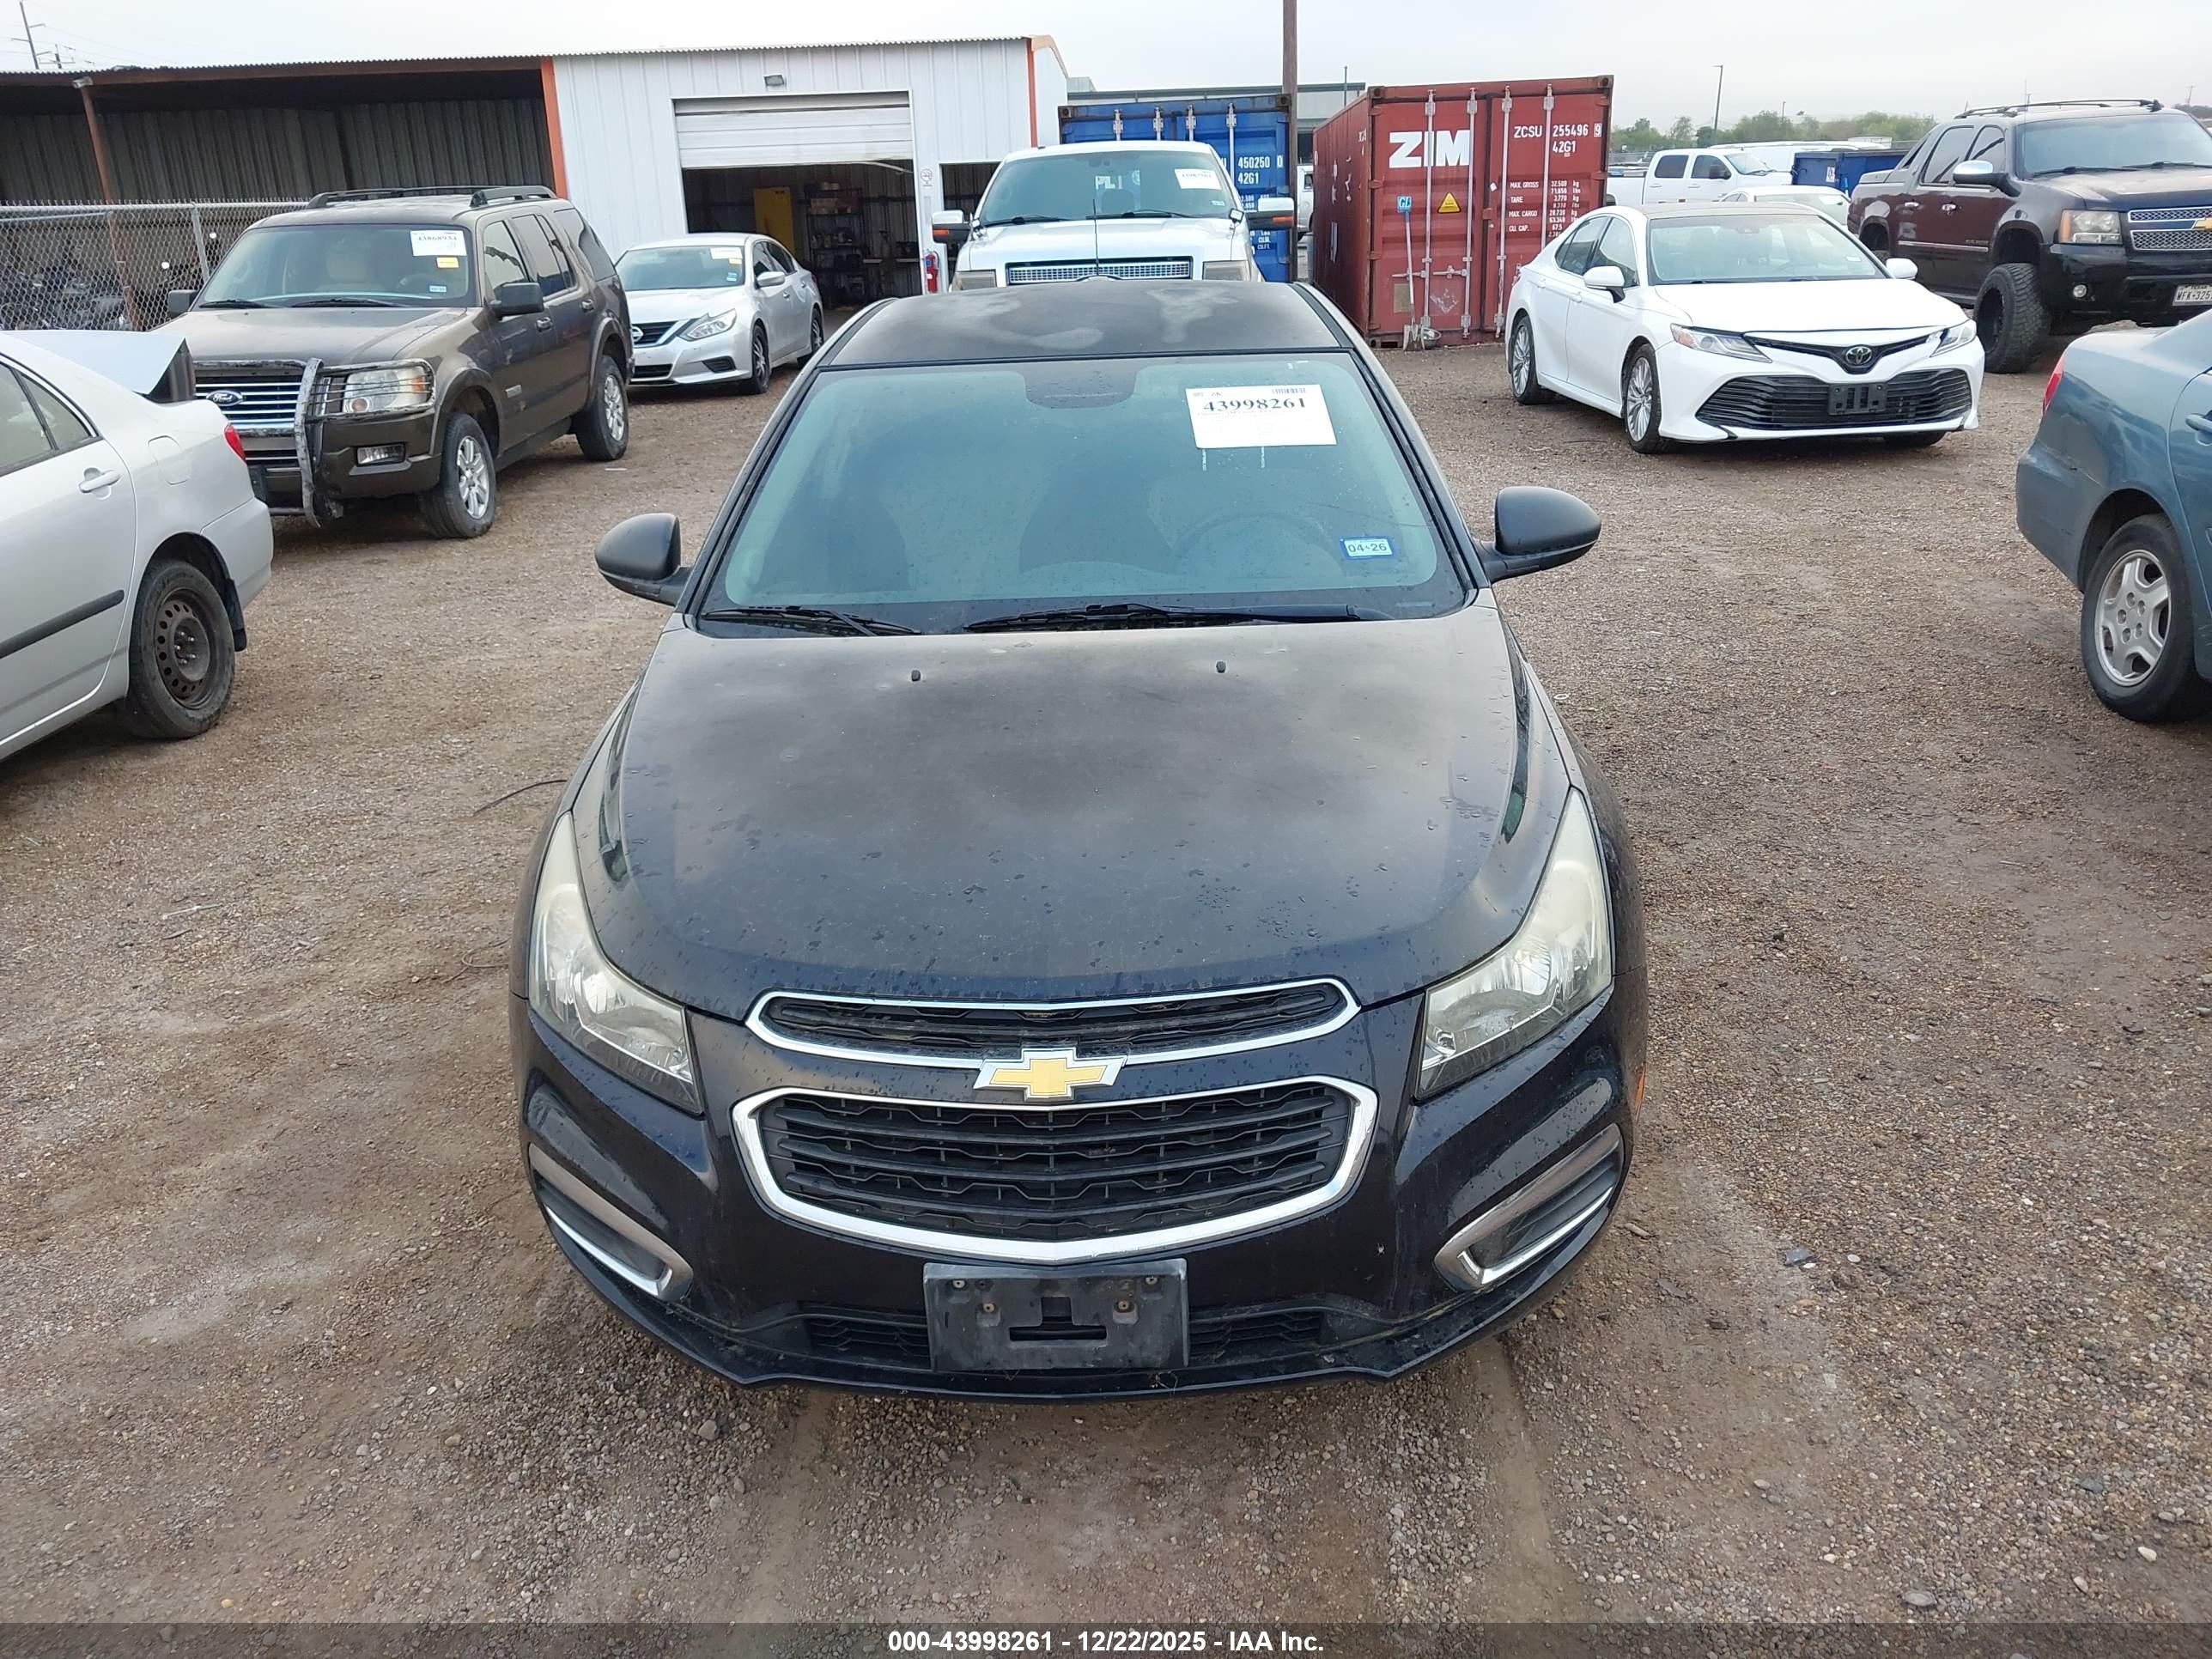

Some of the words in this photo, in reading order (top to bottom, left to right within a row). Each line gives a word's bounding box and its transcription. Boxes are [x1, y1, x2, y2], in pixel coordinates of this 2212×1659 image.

[1514, 125, 1542, 138] ZCSU
[1552, 124, 1589, 137] 255496
[1389, 130, 1471, 168] ZIM
[1552, 140, 1577, 153] 42G1
[1237, 156, 1270, 169] 450250
[1237, 172, 1260, 185] 42G1
[1203, 398, 1306, 412] 43998261
